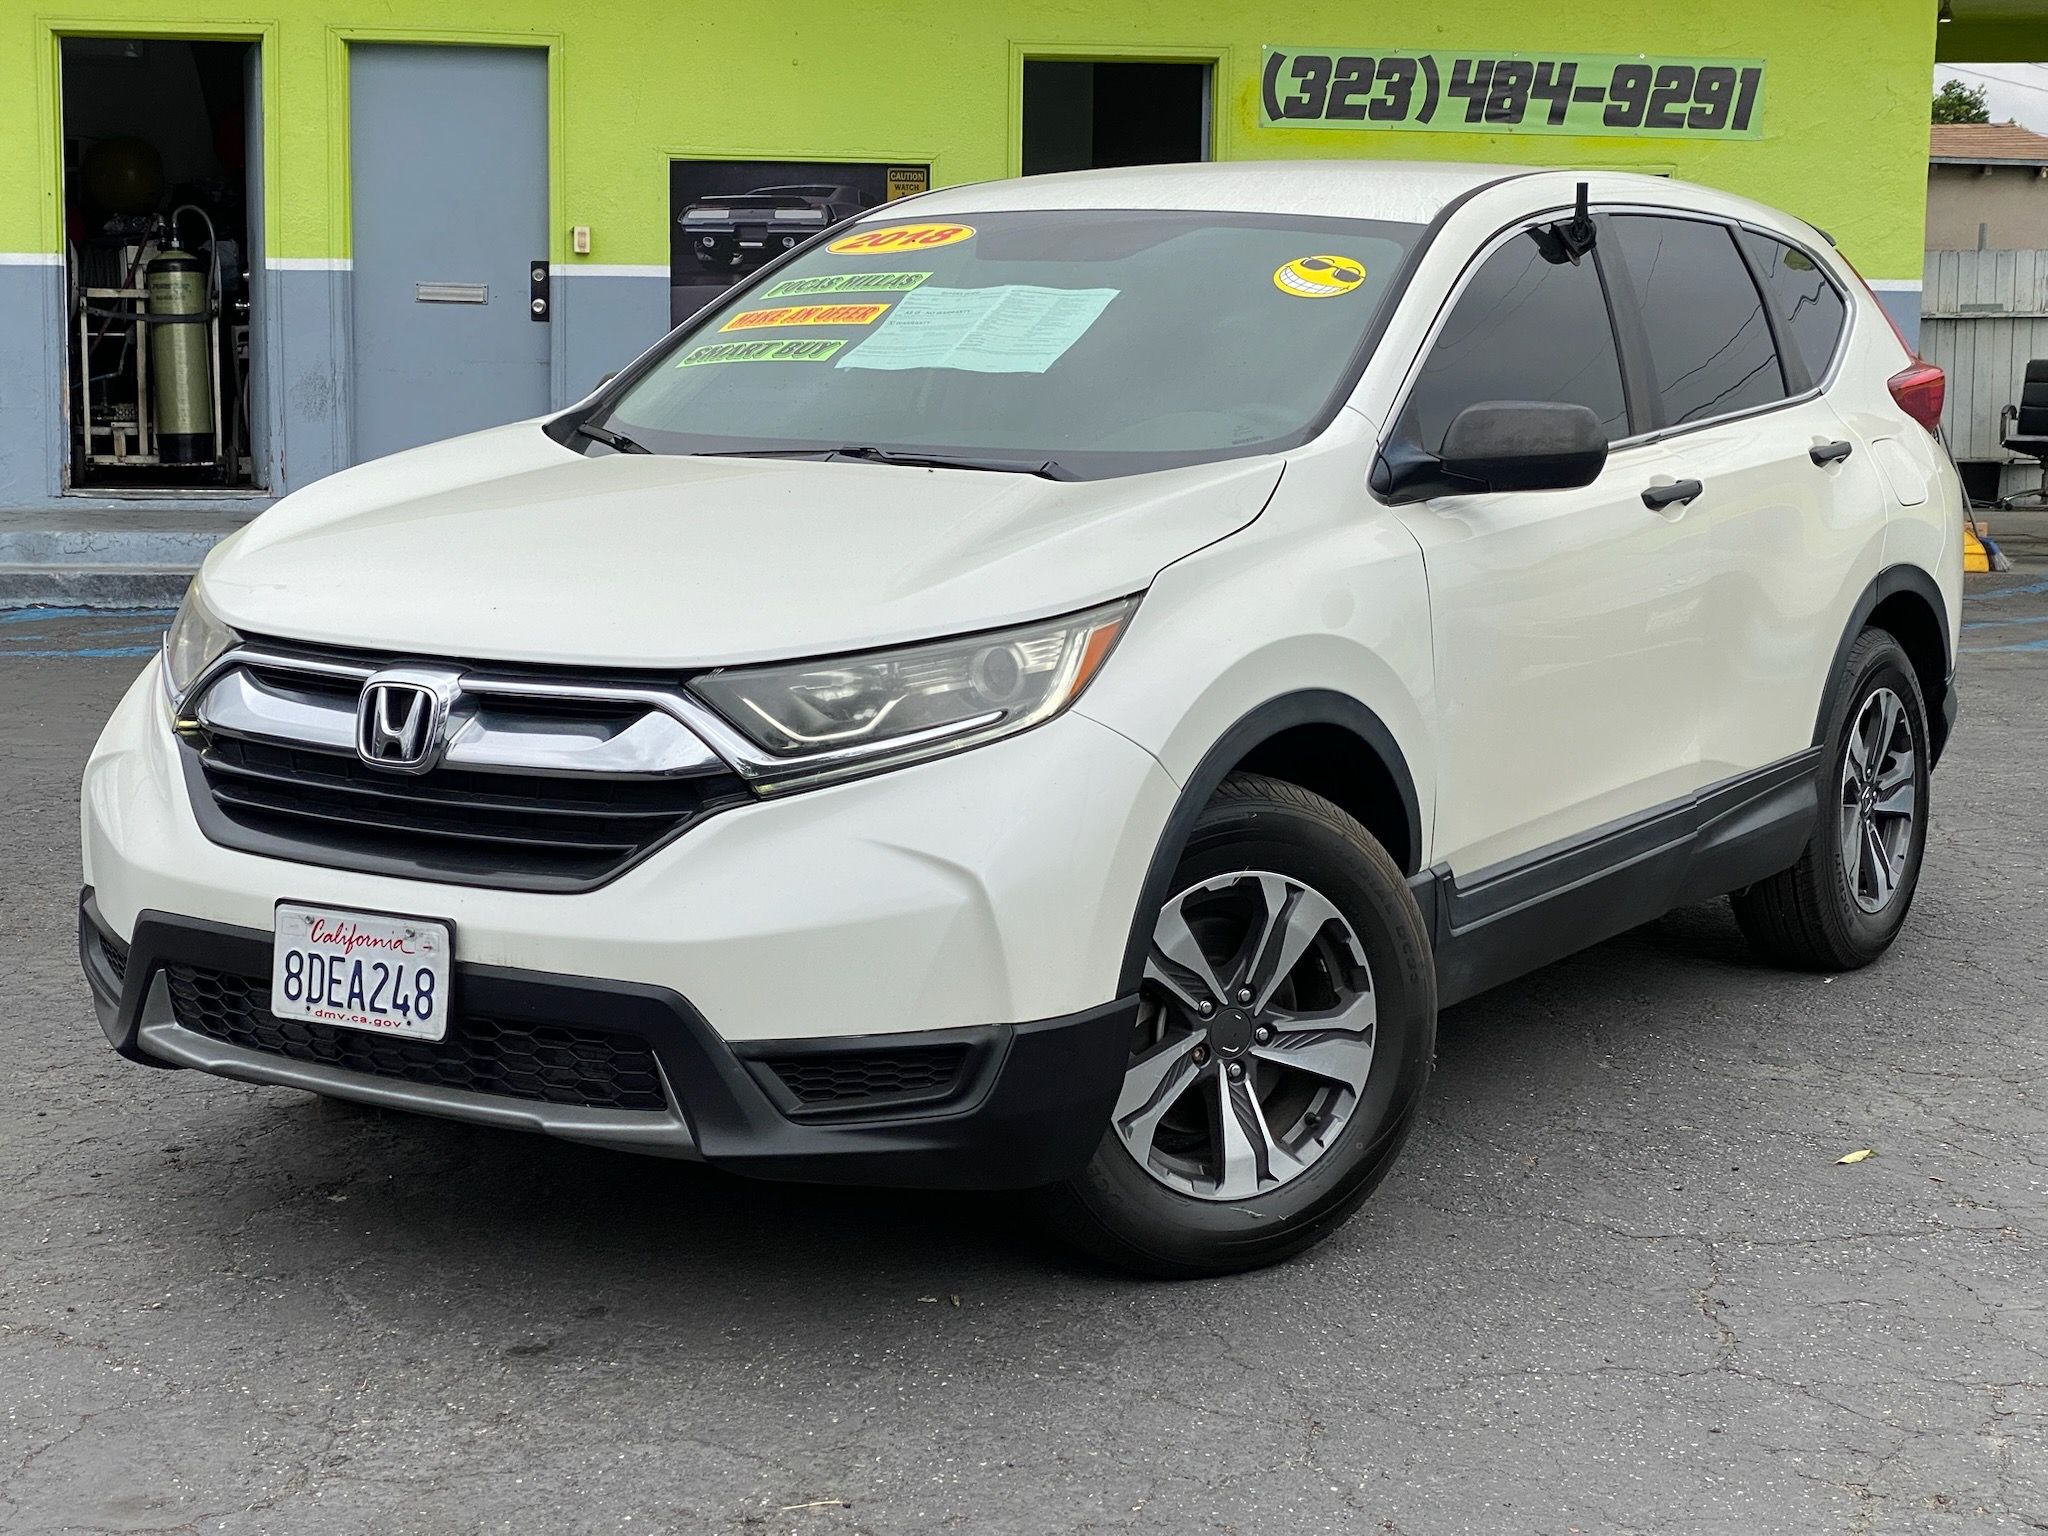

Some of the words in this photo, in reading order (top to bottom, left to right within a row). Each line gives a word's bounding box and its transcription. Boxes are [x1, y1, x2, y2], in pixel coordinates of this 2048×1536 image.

[890, 171, 924, 181] CAUTION
[894, 183, 920, 191] WATCH
[836, 228, 964, 250] 2018
[768, 277, 844, 297] POCAS
[836, 274, 924, 291] MILLAS
[728, 309, 792, 329] MAKE
[780, 306, 824, 324] AN
[814, 305, 880, 322] OFFER
[684, 341, 784, 364] SMART
[772, 340, 841, 358] BUY
[310, 918, 415, 955] California
[284, 950, 435, 1020] 8DEA248
[314, 1009, 402, 1028] dmv.ca.gov
